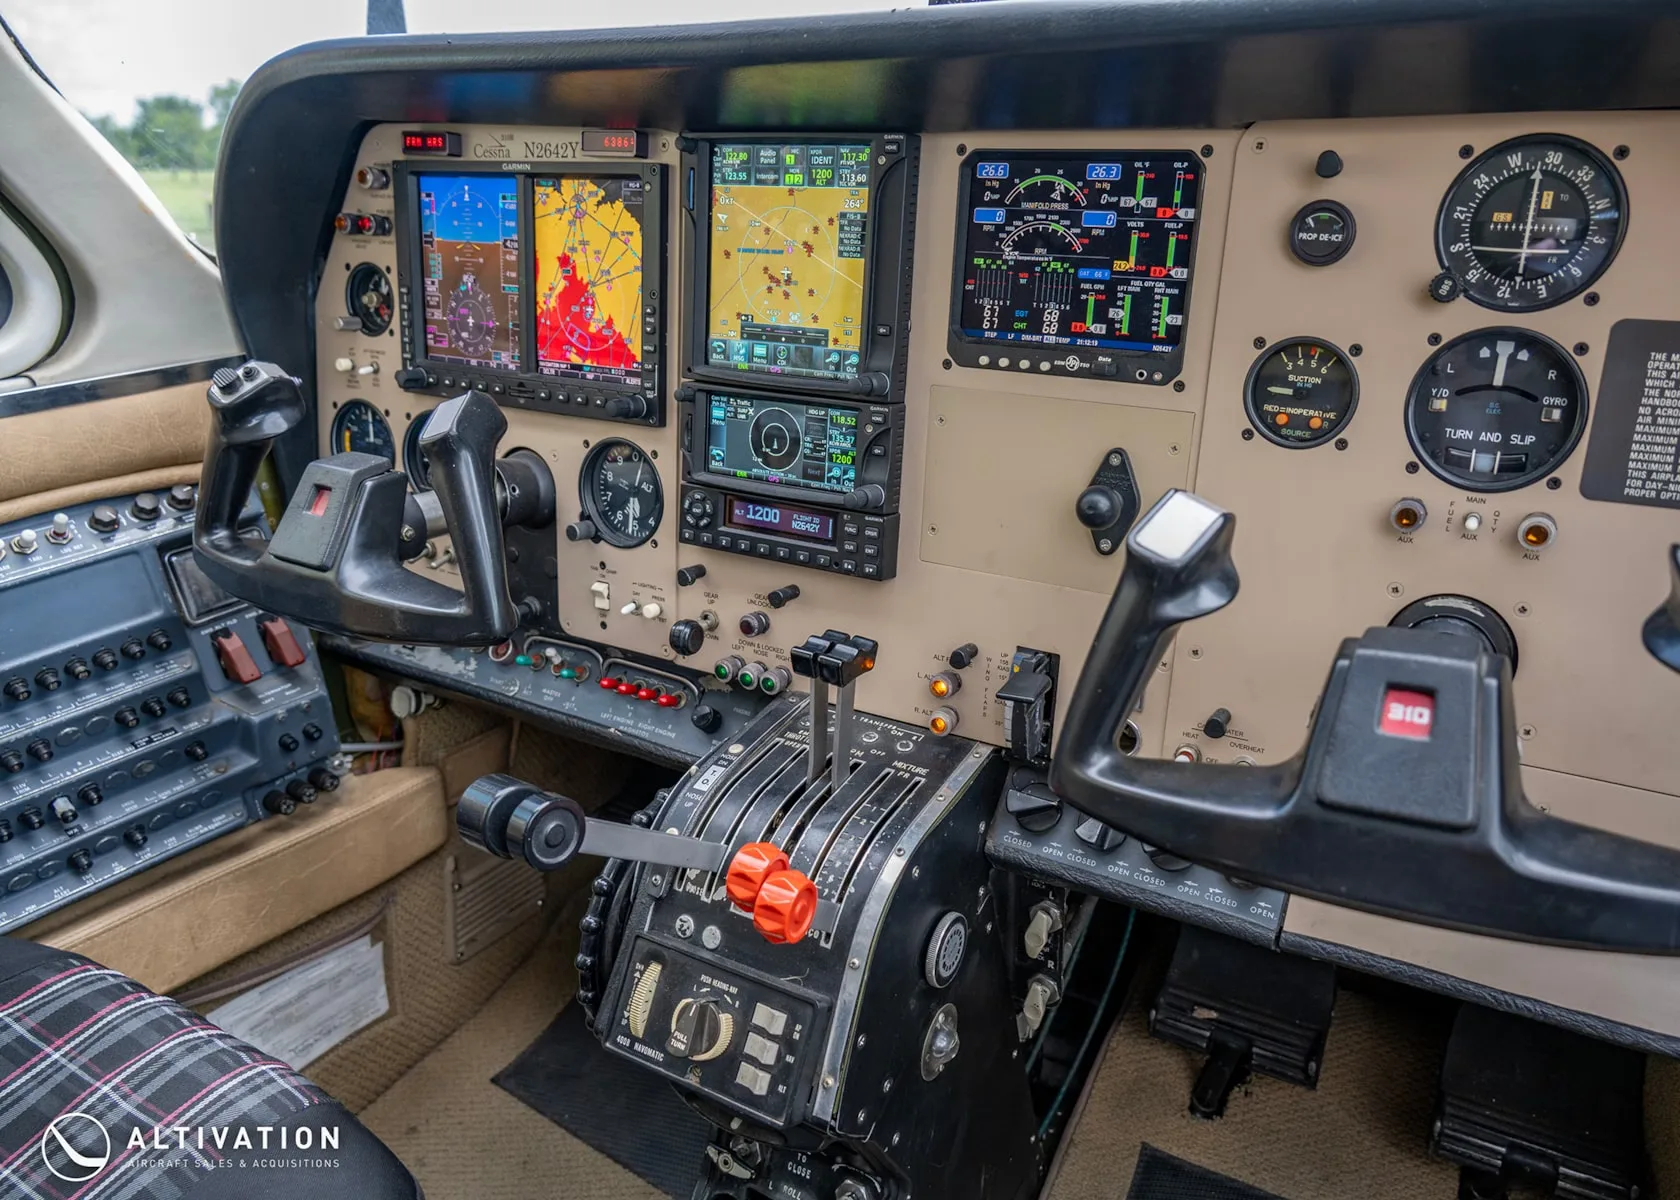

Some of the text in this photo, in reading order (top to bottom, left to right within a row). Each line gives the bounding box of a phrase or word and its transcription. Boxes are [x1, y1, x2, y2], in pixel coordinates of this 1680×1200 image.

[474, 143, 510, 159] Cessna
[525, 142, 579, 159] N2642Y
[725, 152, 747, 161] 122.80
[760, 157, 775, 165] Panel
[812, 156, 832, 164] IDENT
[843, 153, 867, 161] 117.30
[1507, 153, 1522, 168] W
[1545, 151, 1562, 164] 30
[812, 169, 832, 178] 1200
[982, 166, 1004, 176] 26.6
[1092, 167, 1116, 178] 26.3
[1577, 165, 1595, 182] 33
[842, 174, 866, 182] 113.60
[1473, 174, 1490, 189] 24
[1454, 206, 1468, 220] 21
[1466, 269, 1480, 283] 15
[1439, 279, 1453, 296] OBS
[1497, 287, 1511, 298] 12
[984, 306, 999, 317] 67
[1043, 310, 1059, 321] 68
[983, 318, 998, 329] 67
[1042, 323, 1058, 334] 68
[1650, 352, 1667, 361] THE
[1287, 362, 1292, 370] 3
[1447, 363, 1454, 373] L
[1548, 370, 1556, 380] R
[1647, 369, 1667, 378] THIS
[1288, 375, 1321, 384] SUCTION
[1645, 378, 1675, 388] WHICH
[1432, 388, 1449, 397] Y/D
[1644, 388, 1660, 397] THE
[1543, 396, 1567, 406] GYRO
[1638, 406, 1651, 415] NO
[832, 415, 856, 425] 118.52
[1637, 416, 1652, 424] AIR
[1281, 428, 1311, 438] SOURCE
[1635, 424, 1680, 435] MAXIMUM
[831, 435, 855, 444] 135.37
[1445, 428, 1536, 445] TURN AND SLIP
[1633, 433, 1678, 444] MAXIMUM
[1631, 443, 1675, 453] MAXIMUM
[832, 454, 852, 464] 1200
[1629, 452, 1674, 462] MAXIMUM
[1628, 461, 1672, 471] MAXIMUM
[1628, 469, 1647, 478] THIS
[641, 482, 654, 493] ALT
[1626, 479, 1642, 487] FOR
[1624, 488, 1656, 498] PROPER
[1466, 496, 1486, 504] MAIN
[746, 505, 779, 523] 1200
[792, 520, 820, 532] N2642Y
[1522, 553, 1540, 561] AUX
[704, 591, 719, 600] GEAR
[738, 639, 755, 647] DOWN
[762, 644, 784, 654] LOCKED
[753, 649, 768, 657] NOSE
[1388, 702, 1431, 726] 310
[613, 715, 634, 726] ENGINE
[654, 727, 676, 738] ENGINE
[860, 717, 896, 730] TRANSFER
[1183, 731, 1199, 739] HEAT
[1229, 741, 1265, 754] OVERHEAT
[720, 753, 737, 761] NOSE
[892, 760, 929, 775] MIXTURE
[1004, 834, 1032, 849] CLOSED
[1042, 846, 1063, 857] OPEN
[1066, 853, 1096, 867] CLOSED
[1108, 864, 1130, 876] OPEN
[1134, 872, 1165, 887] CLOSED
[1177, 885, 1200, 897] OPEN
[1204, 892, 1237, 908] CLOSED
[1250, 906, 1274, 920] OPEN
[700, 974, 712, 985] PUSH
[673, 1031, 687, 1043] PULL
[670, 1039, 686, 1050] TURN
[633, 1041, 664, 1062] NAVOMATIC
[786, 1054, 795, 1064] NAV
[778, 1084, 786, 1094] ALT
[787, 1161, 812, 1179] CLOSE
[768, 1181, 801, 1200] L ROLL
